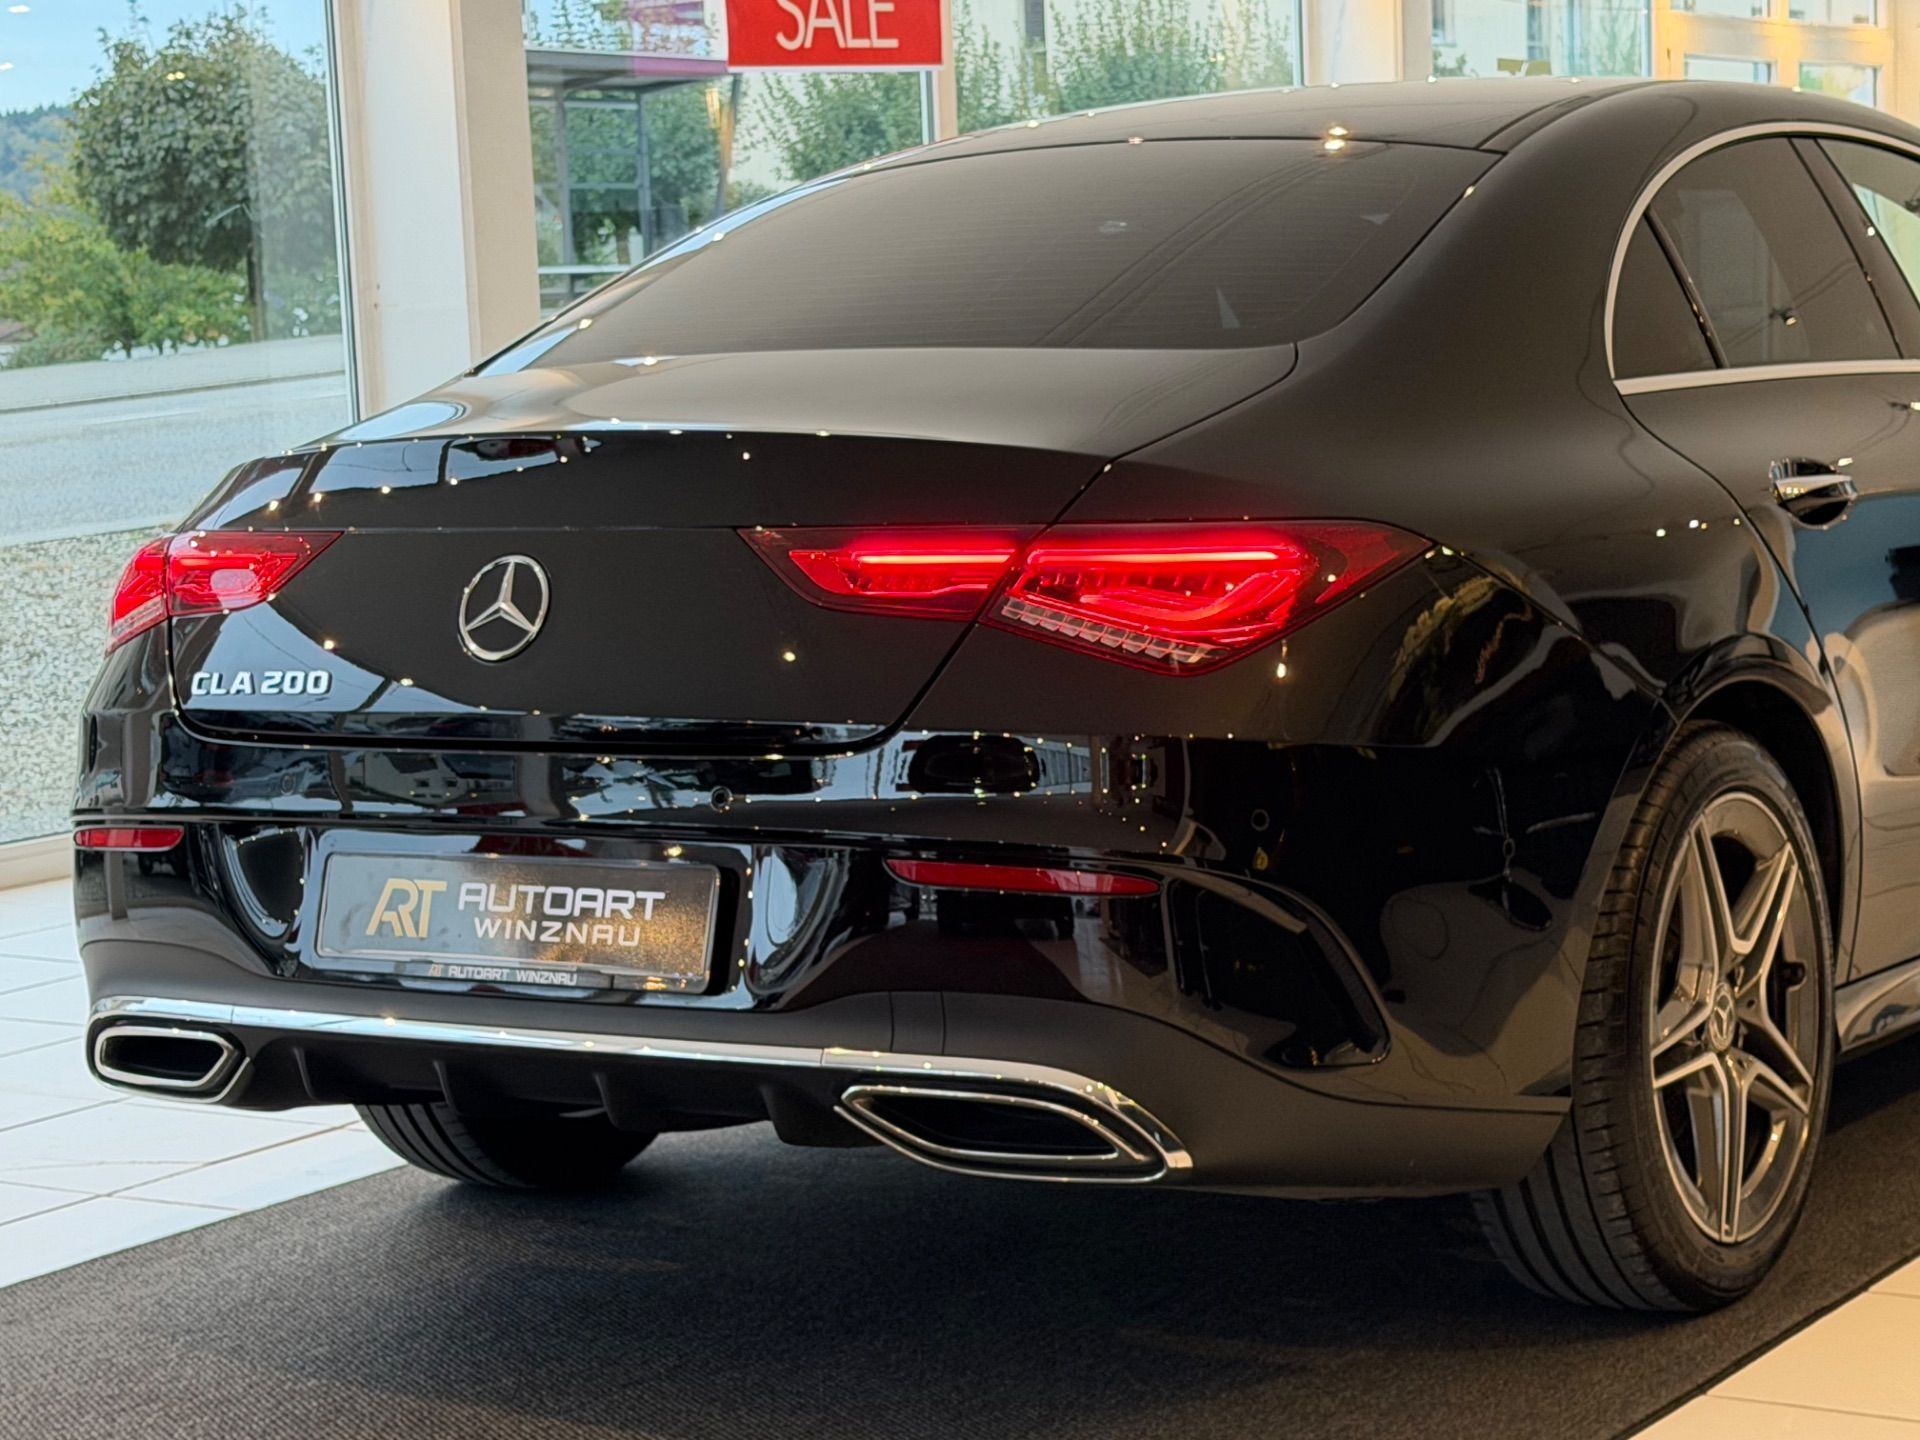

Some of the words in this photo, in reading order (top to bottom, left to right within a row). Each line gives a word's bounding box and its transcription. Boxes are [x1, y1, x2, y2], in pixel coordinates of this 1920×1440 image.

[776, 0, 899, 50] SALE
[191, 671, 252, 695] CLA
[260, 670, 331, 695] 200
[458, 882, 666, 920] AUTOART
[474, 916, 641, 947] WINZNAU
[448, 965, 510, 982] AUTOART
[516, 969, 578, 986] WINZNAU
